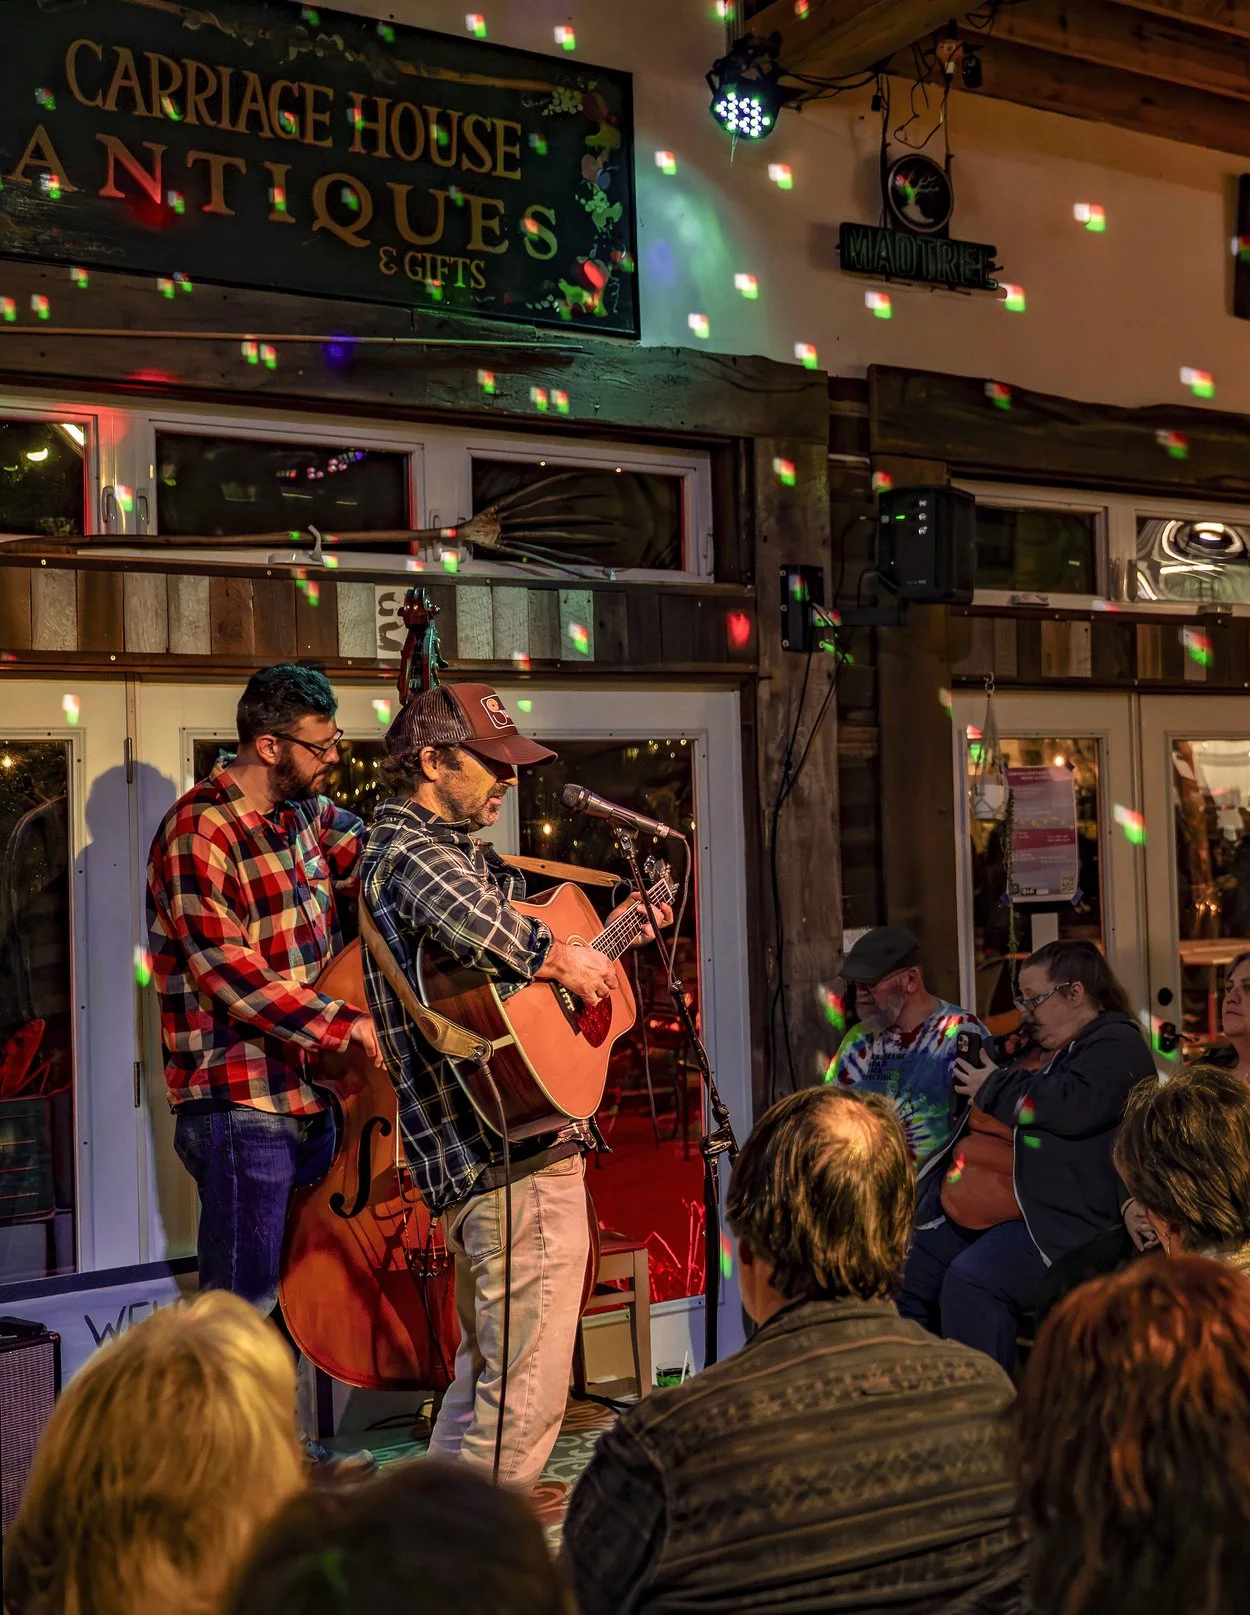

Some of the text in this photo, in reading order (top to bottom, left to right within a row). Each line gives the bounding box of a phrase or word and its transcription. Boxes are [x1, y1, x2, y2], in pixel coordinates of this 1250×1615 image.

[66, 39, 523, 181] CARRIAGE HOUSE
[7, 123, 559, 260] ANTIQUES
[379, 246, 487, 290] & GIFTS
